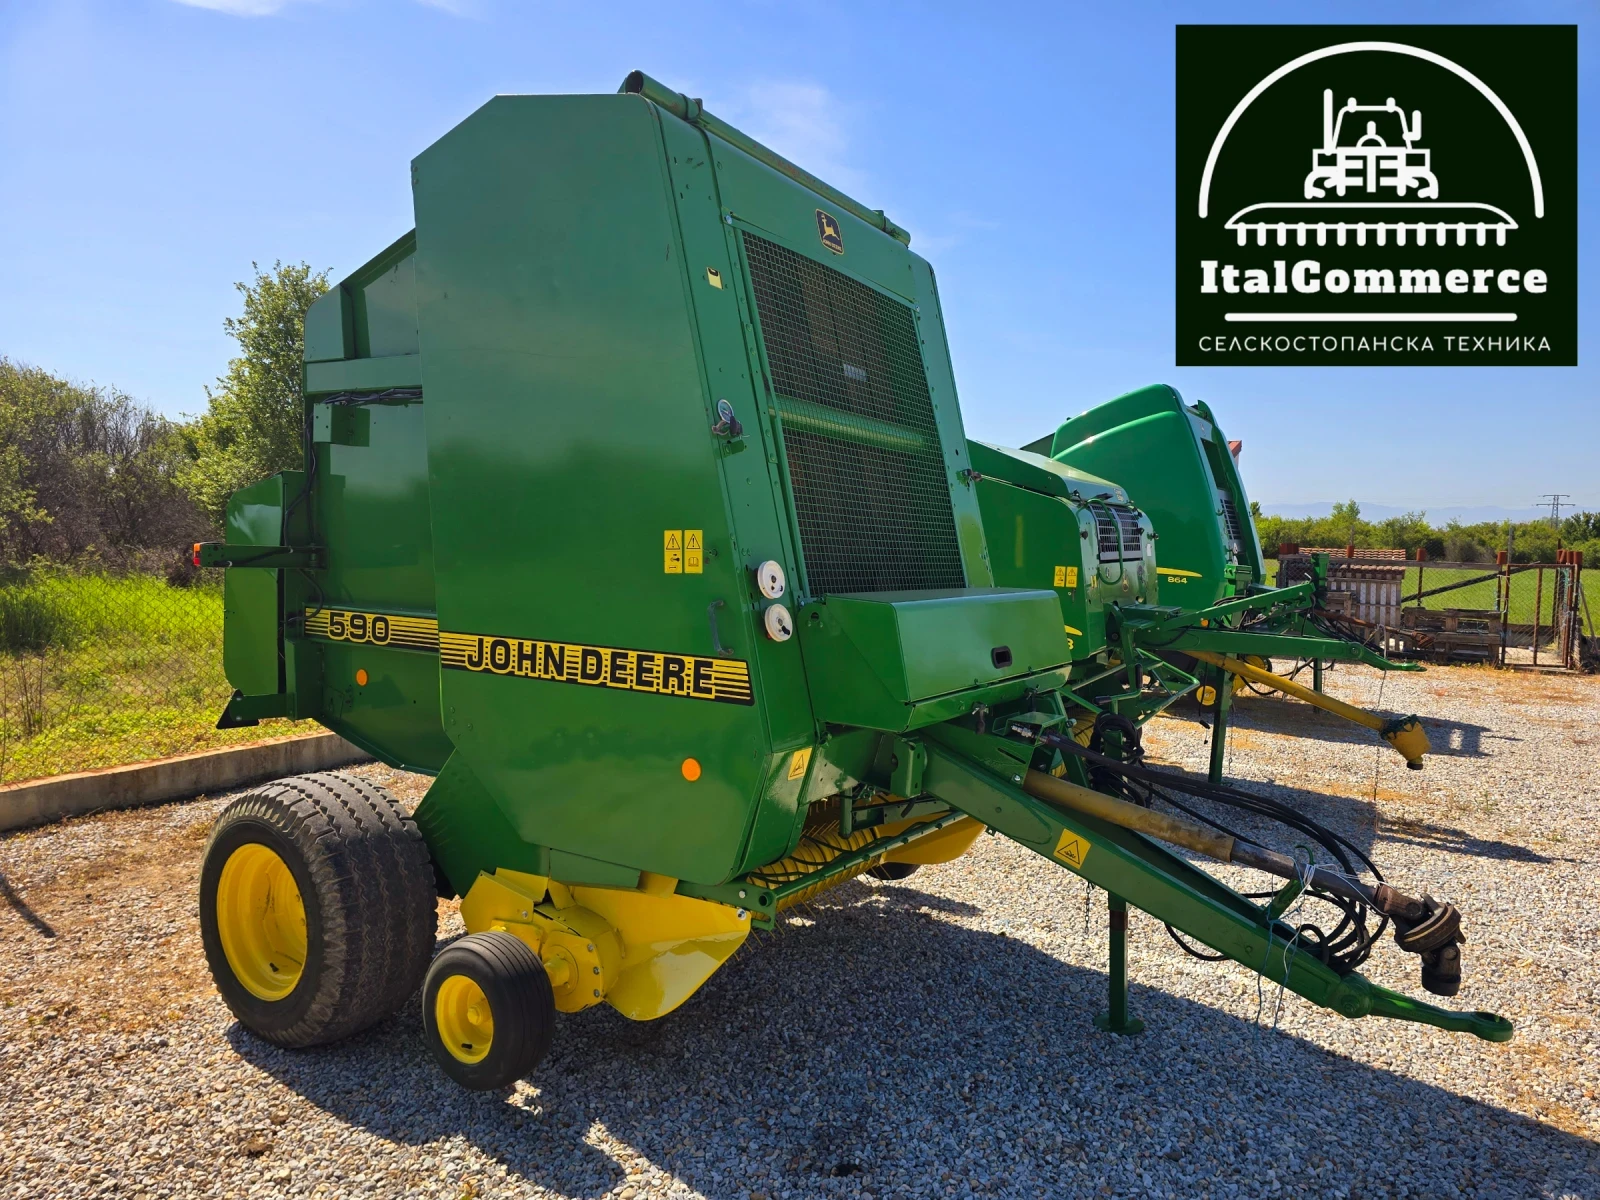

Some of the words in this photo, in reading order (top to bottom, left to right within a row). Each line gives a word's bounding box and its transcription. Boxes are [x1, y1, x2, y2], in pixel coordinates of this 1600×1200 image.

[1167, 576, 1188, 584] 864
[328, 612, 391, 645] 590
[466, 636, 567, 681] JOHN
[579, 648, 717, 700] DEERE
